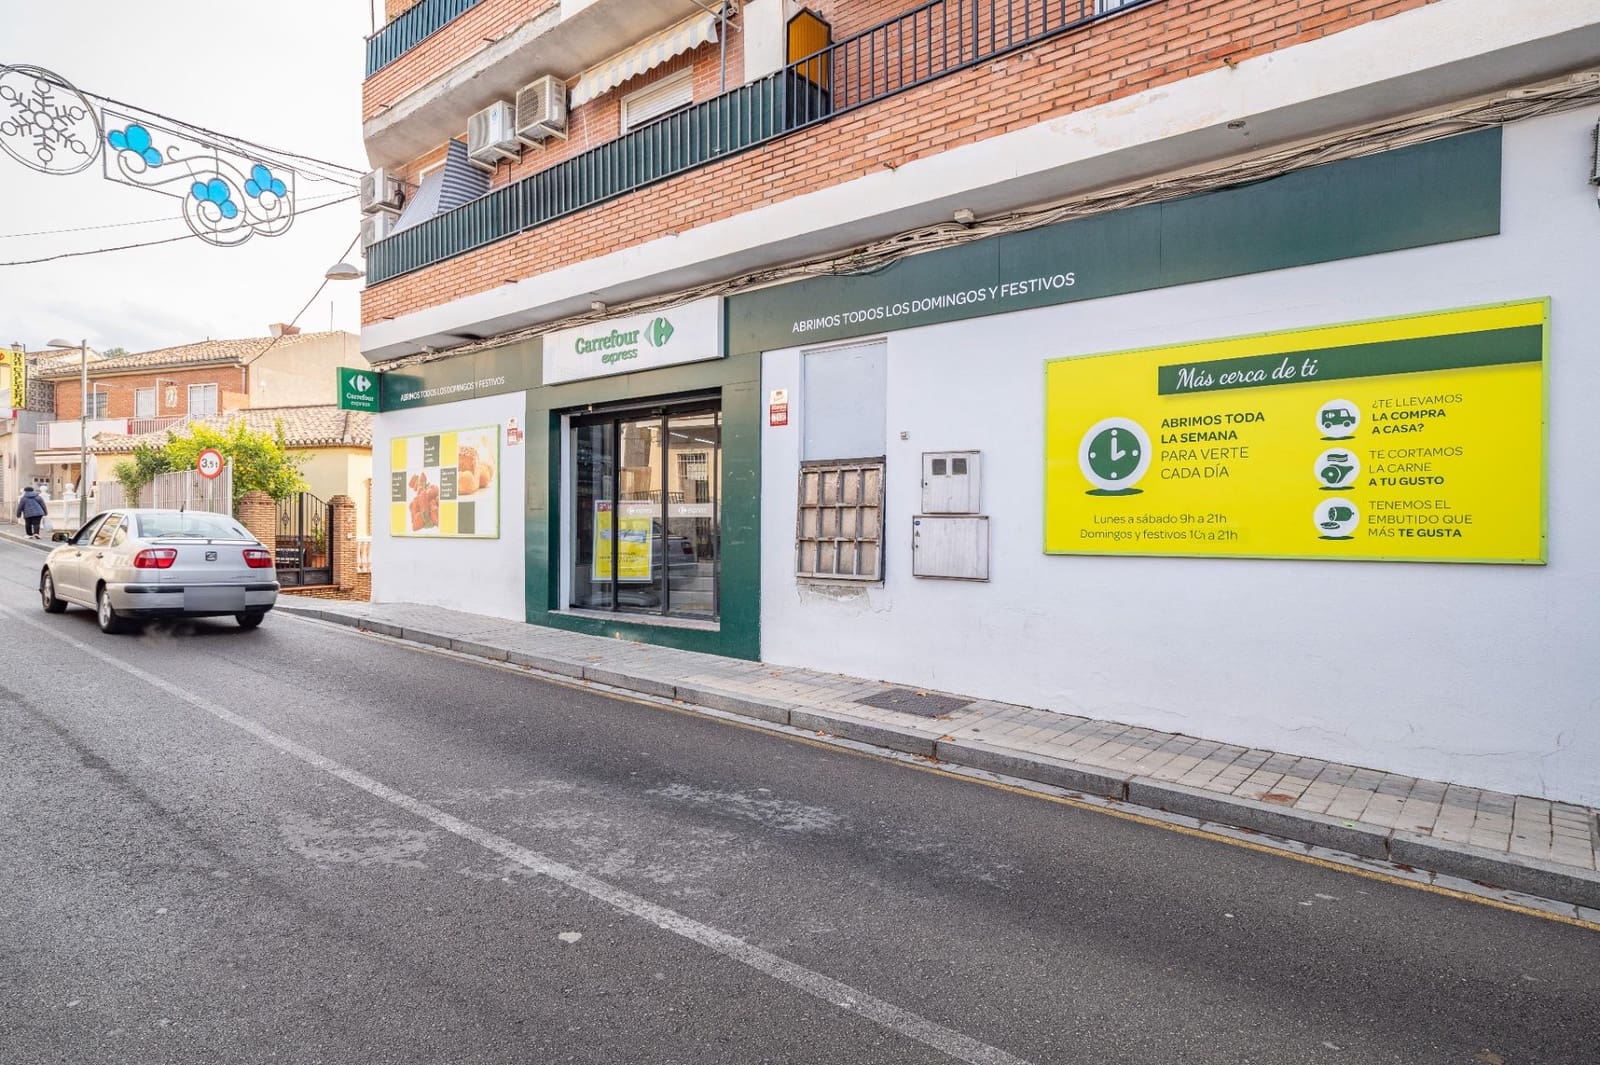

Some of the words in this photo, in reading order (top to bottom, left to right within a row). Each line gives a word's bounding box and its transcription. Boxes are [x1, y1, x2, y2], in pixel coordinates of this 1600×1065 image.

[792, 314, 841, 333] ABRIMOS
[842, 306, 884, 325] TODOS
[886, 302, 910, 317] LOS
[911, 288, 986, 313] DOMINGOS
[989, 286, 998, 300] Y
[1001, 272, 1075, 298] FESTIVOS
[575, 329, 640, 355] Carrefour
[601, 348, 638, 365] express
[1176, 367, 1214, 390] Más
[1219, 368, 1266, 385] cerca
[1272, 357, 1296, 379] de
[1301, 358, 1318, 376] ti
[400, 391, 421, 402] ABRIMOS
[420, 388, 437, 399] TODOS
[437, 385, 447, 396] LOS
[446, 381, 474, 394] DOMINGOS
[478, 375, 505, 389] FESTIVOS
[346, 392, 374, 402] Carrefour
[1372, 399, 1393, 409] ¿TE
[1395, 394, 1463, 408] LLEVAMOS
[1161, 414, 1222, 429] ABRIMOS
[1225, 411, 1265, 424] TODA
[1372, 413, 1388, 422] LA
[1390, 409, 1447, 421] COMPRA
[1372, 426, 1380, 435] A
[1383, 423, 1424, 434] CASA?
[1161, 433, 1178, 444] LA
[1180, 430, 1238, 443] SEMANA
[1161, 449, 1197, 462] PARA
[1200, 446, 1249, 460] VERTE
[1369, 450, 1385, 460] TE
[1387, 446, 1464, 459] CORTAMOS
[1161, 467, 1201, 480] CADA
[1204, 463, 1229, 478] DÍA
[1369, 464, 1385, 474] LA
[1387, 462, 1432, 473] CARNE
[1368, 478, 1378, 487] A
[1380, 477, 1396, 487] TU
[1399, 476, 1445, 486] GUSTO
[1369, 500, 1432, 510] TENEMOS
[1435, 500, 1451, 509] EL
[1094, 514, 1126, 524] Lunes
[1127, 516, 1135, 524] a
[1136, 513, 1178, 524] sábado
[1179, 514, 1195, 523] 9h
[1198, 515, 1205, 523] a
[1206, 513, 1227, 523] 21h
[1368, 515, 1440, 525] EMBUTIDO
[1442, 514, 1473, 525] QUE
[1080, 528, 1133, 541] Domingos
[1135, 531, 1142, 540] y
[1143, 529, 1187, 539] festivos
[1207, 532, 1215, 541] a
[1217, 529, 1238, 541] 21h
[1368, 526, 1396, 537] MÁS
[1398, 528, 1414, 537] TE
[1416, 528, 1462, 537] GUSTA
